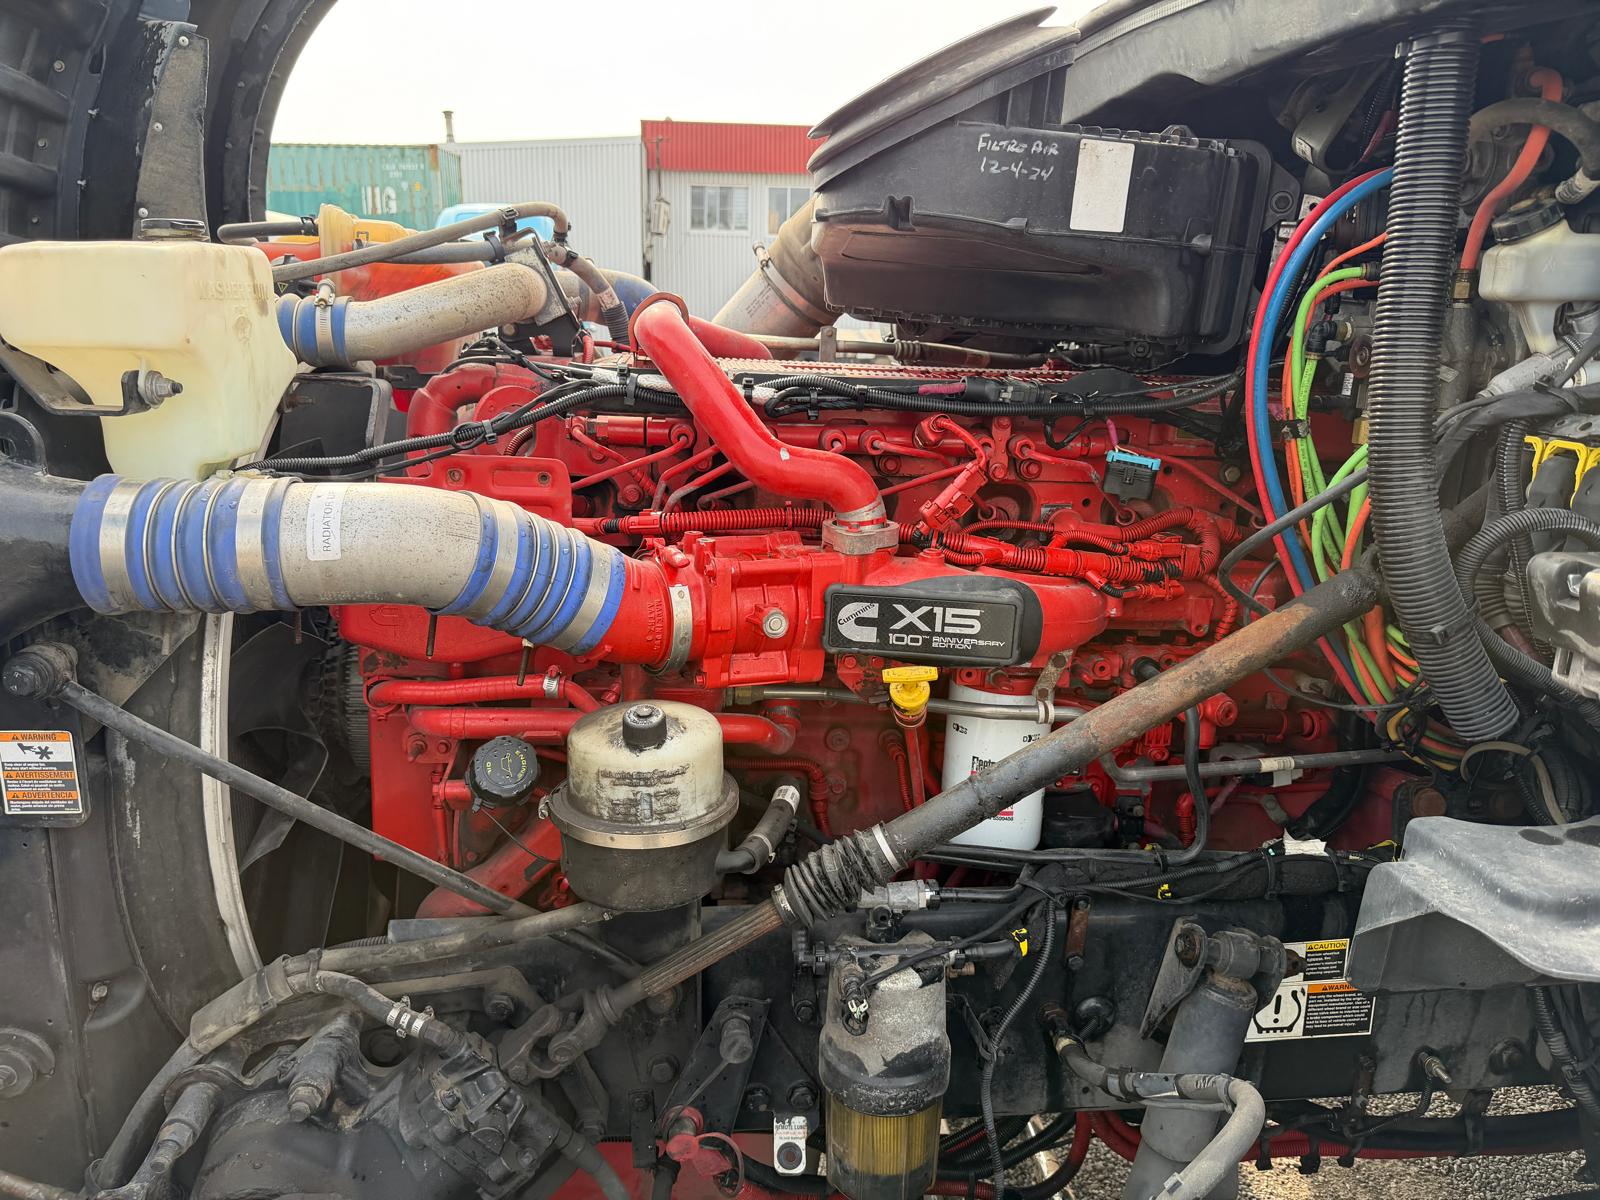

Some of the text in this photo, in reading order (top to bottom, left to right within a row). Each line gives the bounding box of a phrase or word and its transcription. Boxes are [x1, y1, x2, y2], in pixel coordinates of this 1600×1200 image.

[837, 602, 875, 625] Cummins
[932, 636, 1006, 647] ANNIVERSARY
[931, 642, 972, 650] EDITION
[20, 733, 57, 741] WARNING
[15, 771, 73, 779] AVERTISSEMENT
[23, 791, 73, 799] ADVERTENCIA
[1314, 942, 1347, 950] CAUTION
